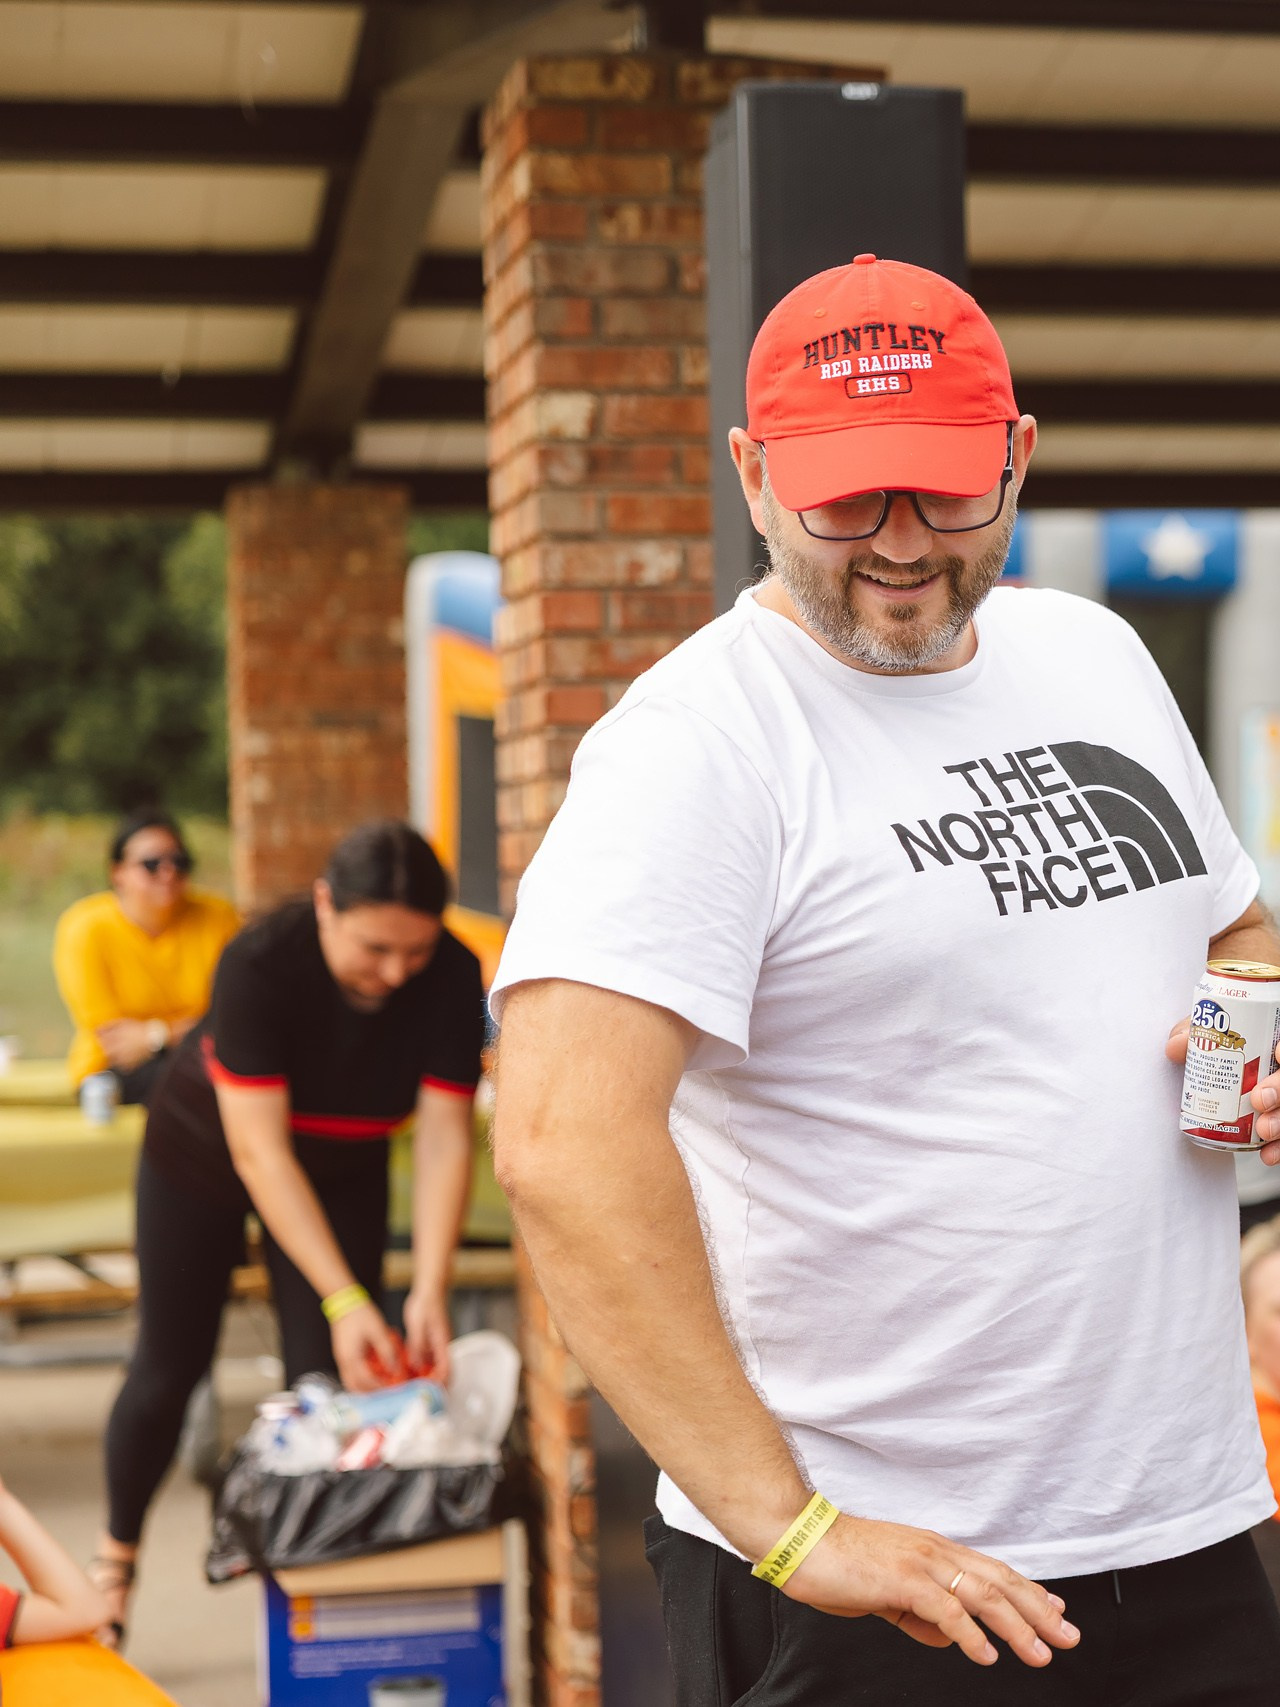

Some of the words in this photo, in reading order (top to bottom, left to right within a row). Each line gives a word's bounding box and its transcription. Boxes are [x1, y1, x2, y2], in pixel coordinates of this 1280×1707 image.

[803, 323, 947, 369] HUNTLEY
[820, 361, 852, 380] RED
[857, 353, 932, 373] RAIDERS
[856, 376, 900, 394] HHS
[943, 746, 1070, 807] THE
[890, 794, 1102, 873] NORTH
[980, 844, 1129, 916] FACE
[1192, 1004, 1230, 1033] 250
[1214, 1124, 1239, 1133] LAGER
[773, 1529, 809, 1570] RAPTOR
[802, 1515, 819, 1533] PIT
